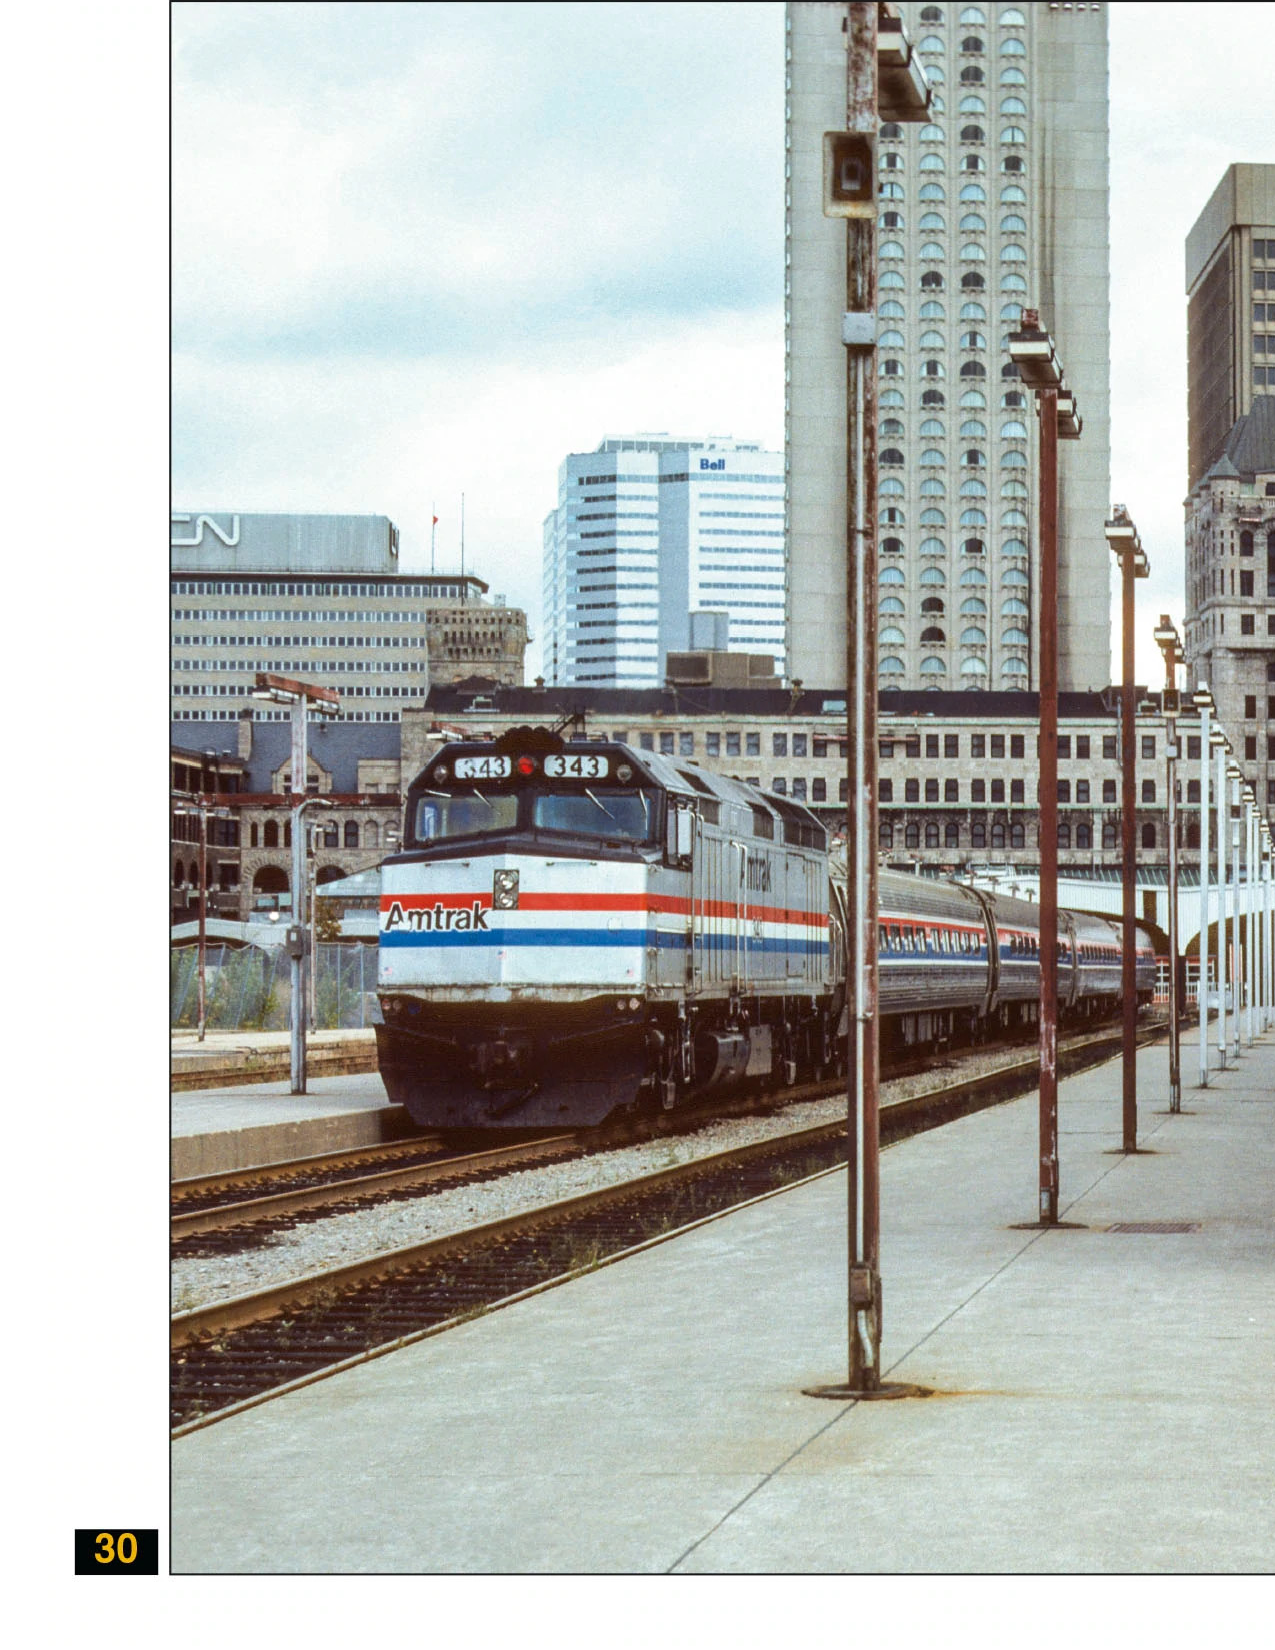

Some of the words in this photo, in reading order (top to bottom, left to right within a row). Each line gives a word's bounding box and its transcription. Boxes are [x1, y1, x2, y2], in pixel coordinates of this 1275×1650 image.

[700, 458, 725, 470] Bell
[464, 759, 505, 779] 343
[554, 756, 599, 776] 343
[385, 903, 489, 931] Amtrak
